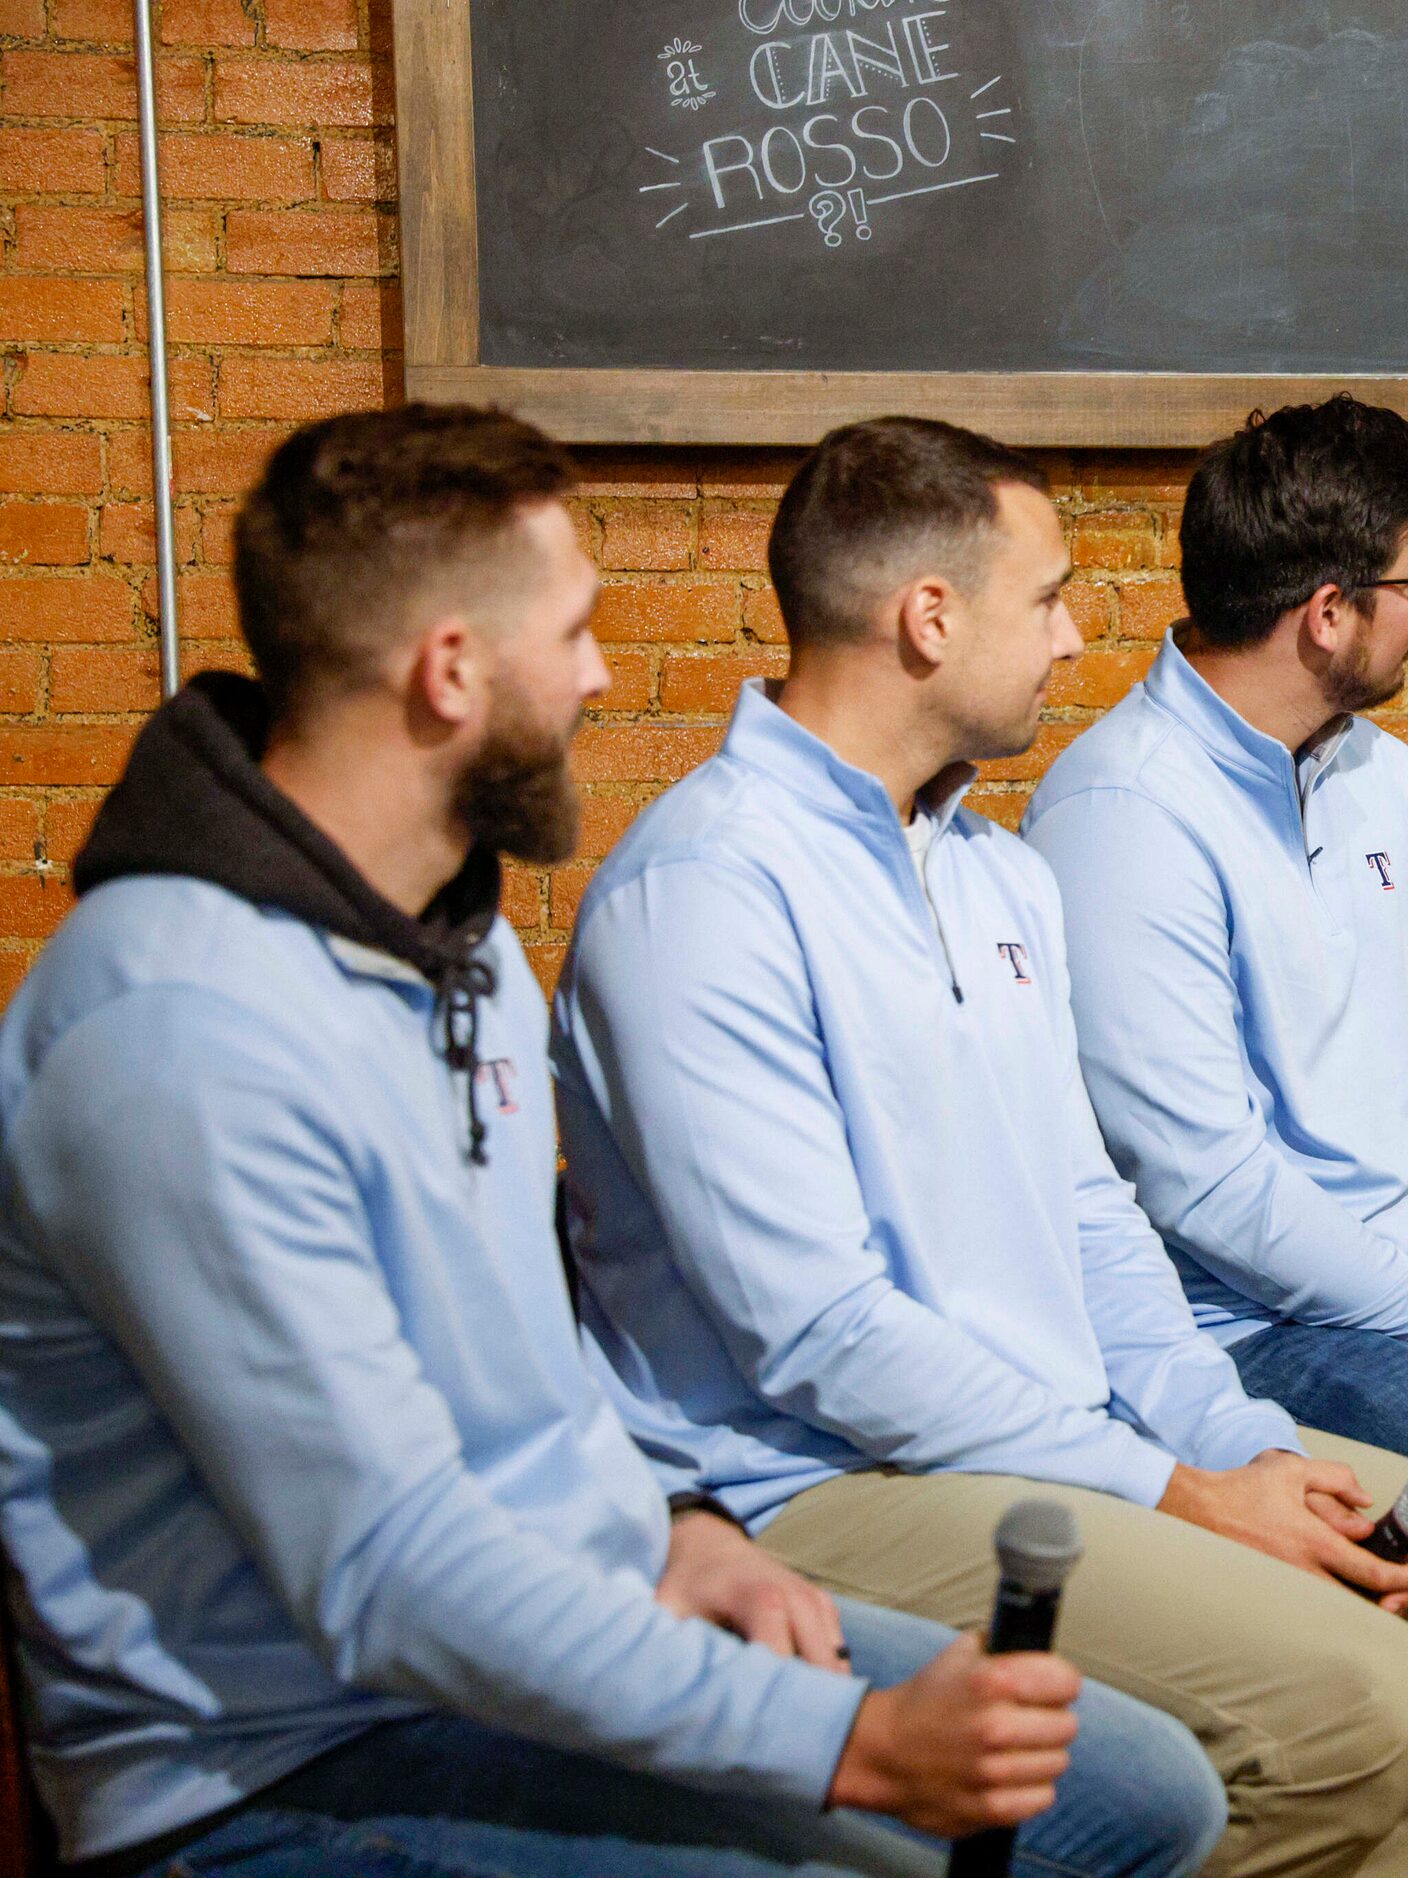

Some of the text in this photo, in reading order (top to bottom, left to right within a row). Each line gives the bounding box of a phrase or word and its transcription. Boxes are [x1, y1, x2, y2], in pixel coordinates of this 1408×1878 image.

[667, 60, 709, 96] at
[749, 10, 959, 109] CANE
[703, 97, 951, 209] ROSSO
[808, 187, 872, 247] ?!
[1364, 851, 1396, 891] T
[996, 942, 1032, 985] T
[474, 1058, 519, 1114] T
